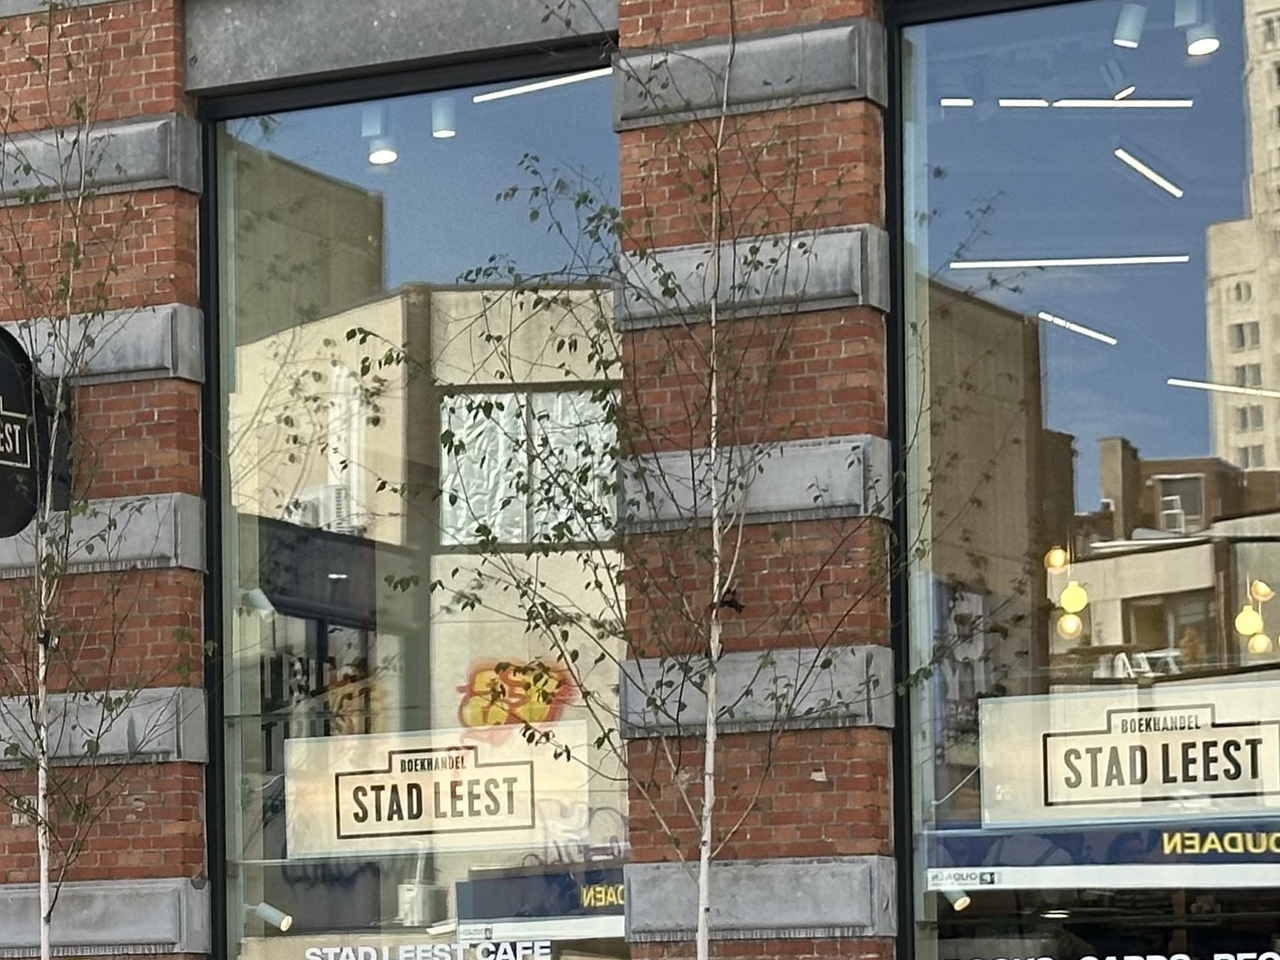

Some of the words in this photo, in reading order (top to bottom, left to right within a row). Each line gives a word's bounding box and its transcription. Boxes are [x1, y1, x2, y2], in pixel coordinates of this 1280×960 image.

[1120, 715, 1202, 734] BOEKHANDEL
[400, 755, 467, 773] BOEKHANDEL
[1063, 744, 1148, 789] STAD
[1161, 738, 1263, 784] LEEST
[352, 783, 423, 823] STAD
[433, 777, 518, 818] LEEST
